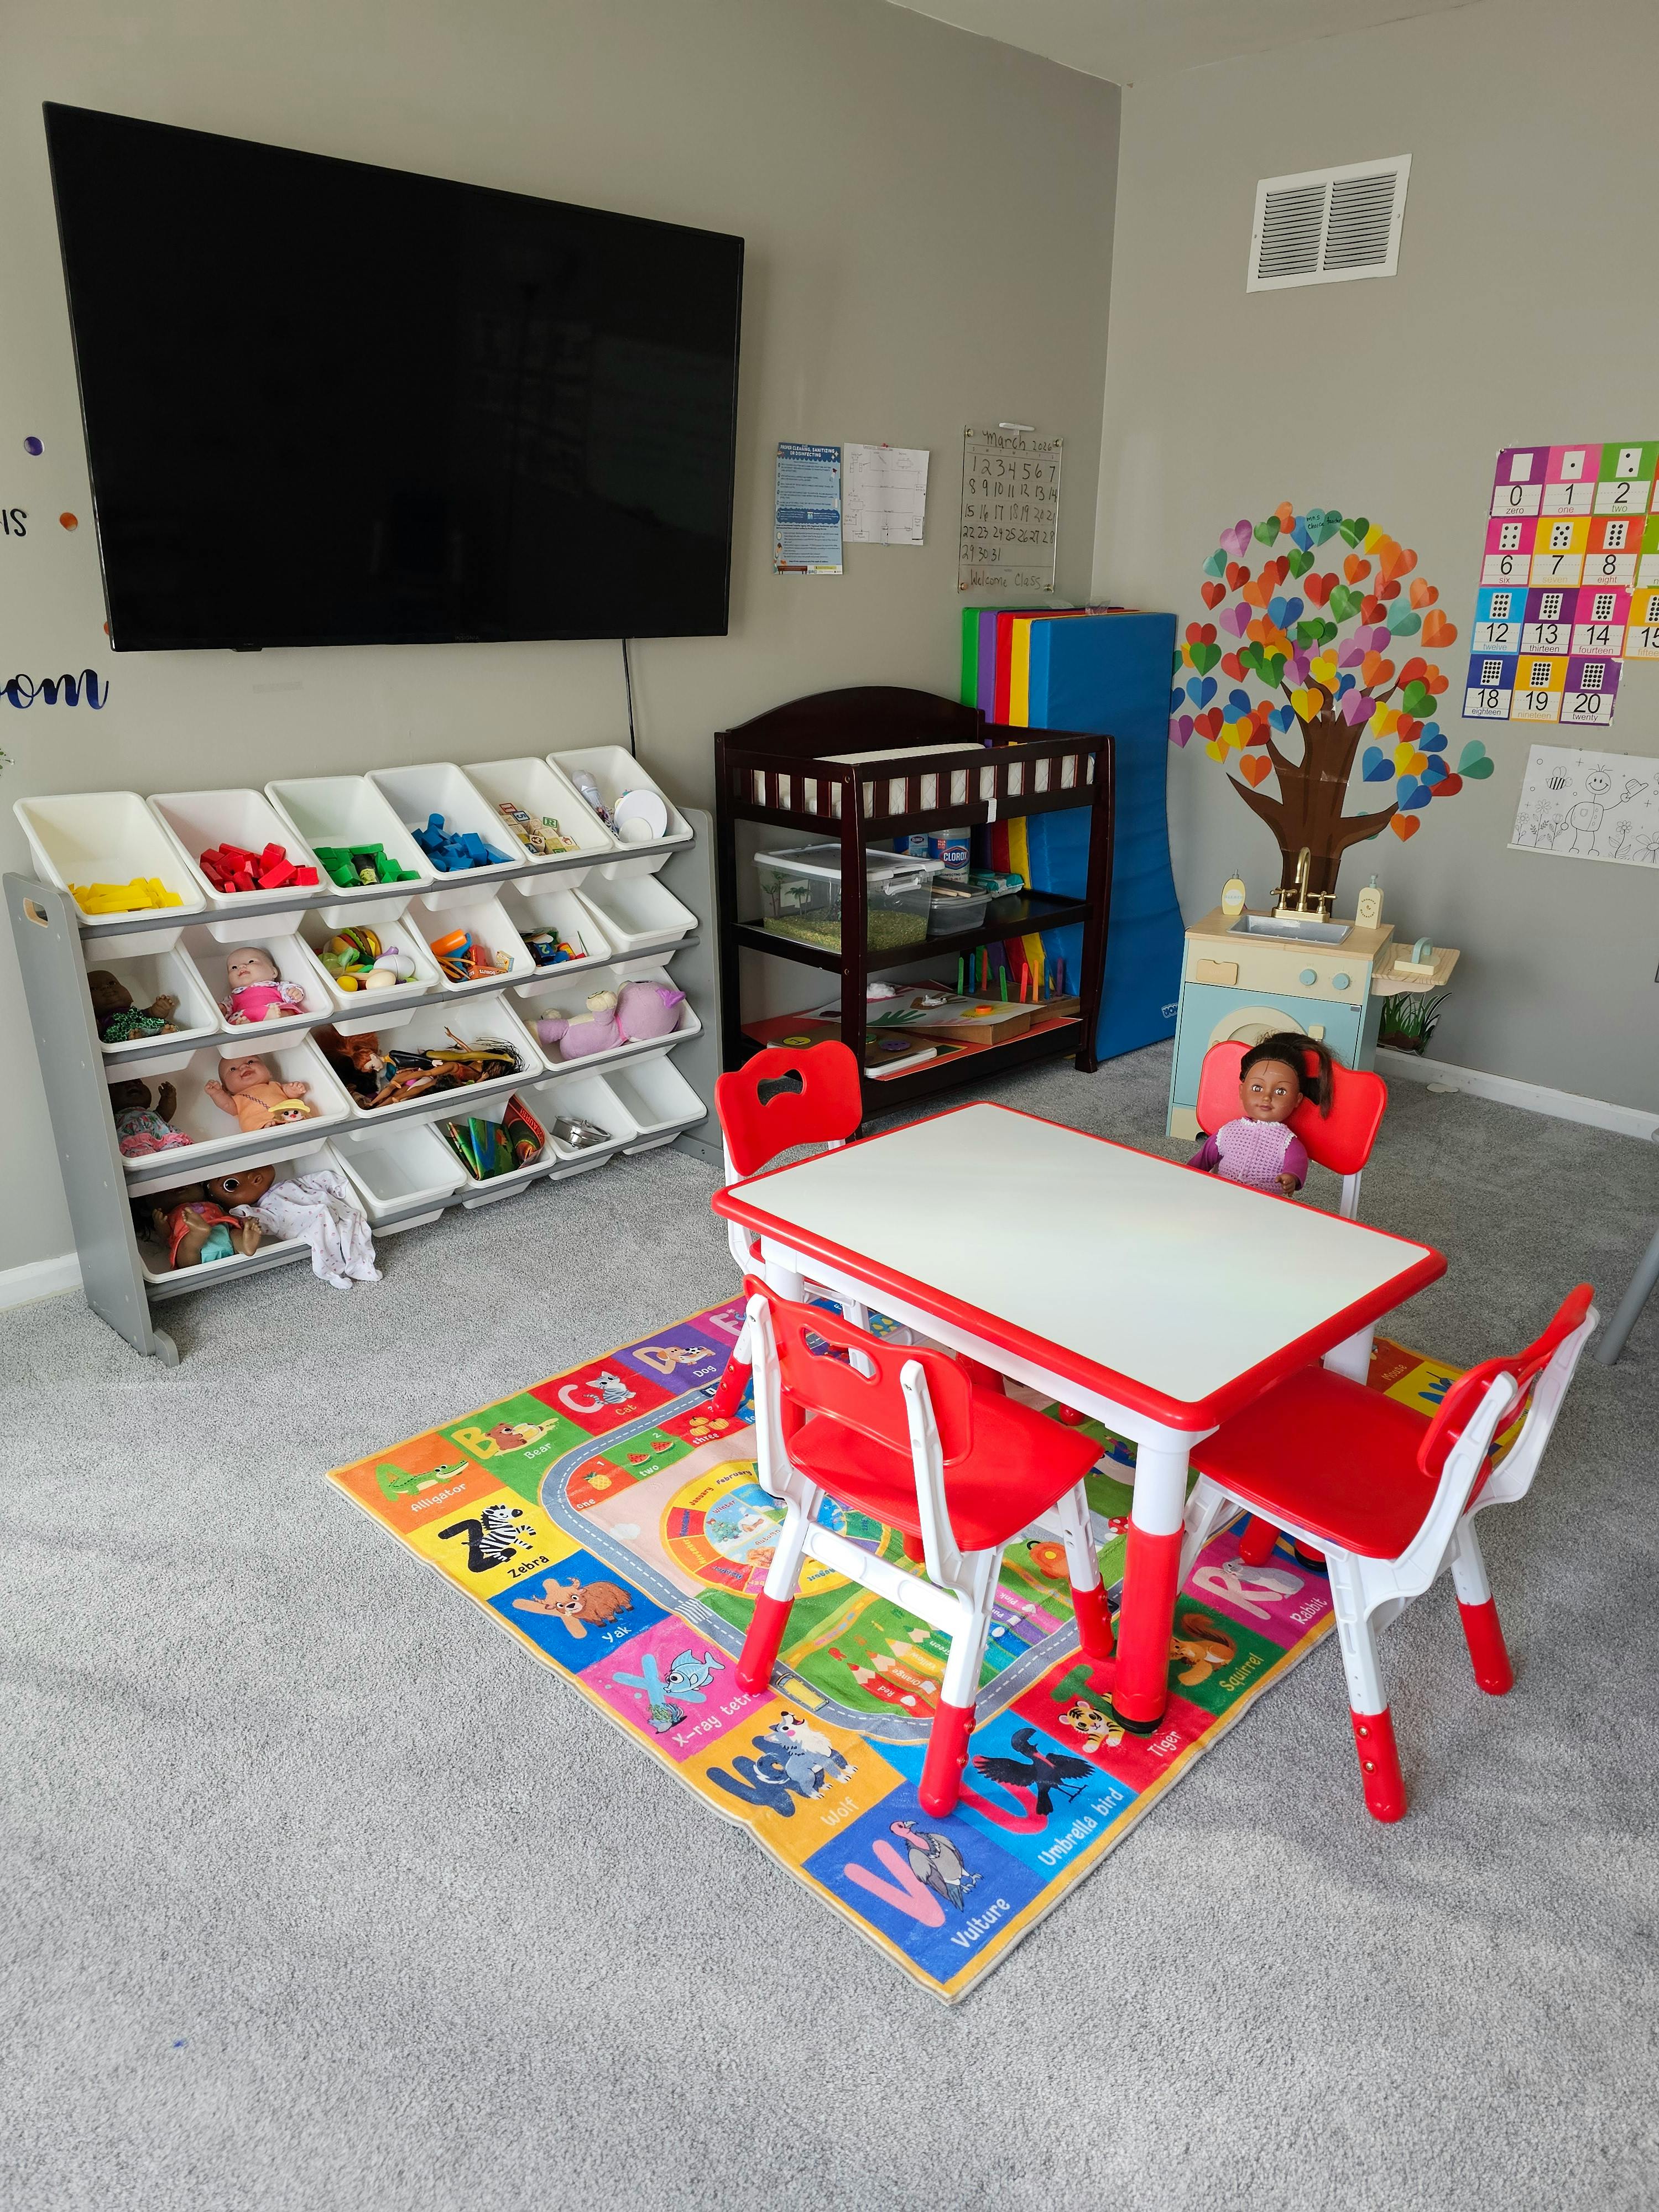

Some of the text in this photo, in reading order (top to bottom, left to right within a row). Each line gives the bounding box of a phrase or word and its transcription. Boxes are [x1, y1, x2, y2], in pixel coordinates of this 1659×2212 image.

[982, 430, 1025, 450] March
[1032, 441, 1052, 451] 2026
[973, 456, 1055, 482] 1 2 3 4 5 6 7
[969, 479, 1057, 502] 8 9 10 11 12 13 14
[1510, 482, 1631, 506] 0 1 2
[964, 503, 1055, 525] 15 16 17 18 19 20 21
[1611, 504, 1627, 513] two
[963, 526, 1055, 544] 22 23 24 25 26 27 28
[962, 545, 1000, 562] 29 30 31
[1500, 554, 1616, 575] 6 7 8
[971, 569, 1040, 589] Welcome Class
[1499, 576, 1510, 584] six
[1597, 576, 1618, 585] eight
[1486, 623, 1509, 642] 12
[1535, 624, 1558, 644] 13
[1585, 625, 1610, 645] 14
[1483, 643, 1507, 651] twelve
[1578, 646, 1614, 655] fourteen
[1638, 648, 1659, 656] fiftee
[1477, 689, 1601, 713] 18 19 20
[1472, 708, 1599, 722] eighteen nineteen twenty
[943, 852, 968, 862] CLOROX
[632, 1347, 676, 1374] D
[692, 1365, 717, 1378] Dog
[1381, 1364, 1408, 1381] Mouse
[557, 1384, 604, 1414] C
[615, 1405, 637, 1416] Cat
[451, 1427, 501, 1460] B
[692, 1432, 719, 1445] three
[524, 1442, 552, 1460] Bear
[639, 1464, 660, 1478] two
[716, 1470, 753, 1485] February
[410, 1483, 467, 1512] Alligator
[576, 1498, 596, 1510] one
[689, 1486, 714, 1506] January
[712, 1500, 736, 1514] Winter
[437, 1519, 517, 1573] Z
[755, 1529, 781, 1546] Autumn
[507, 1554, 550, 1579] Zebra
[999, 1592, 1019, 1605] Pink
[1192, 1566, 1283, 1620] R
[512, 1578, 587, 1639] Y
[1290, 1597, 1328, 1625] Rabbit
[602, 1626, 632, 1643] Yak
[911, 1650, 937, 1671] Yellow
[613, 1654, 707, 1704] X
[891, 1668, 921, 1686] Orange
[1219, 1653, 1265, 1692] Squirrel
[877, 1685, 895, 1697] Red
[672, 1715, 722, 1748] X-ray
[1147, 1731, 1182, 1757] Tiger
[820, 1796, 859, 1827] Wolf
[1037, 1786, 1125, 1867] Umbrella bird
[844, 1839, 946, 1928] V
[951, 1897, 1011, 1949] Vulture
